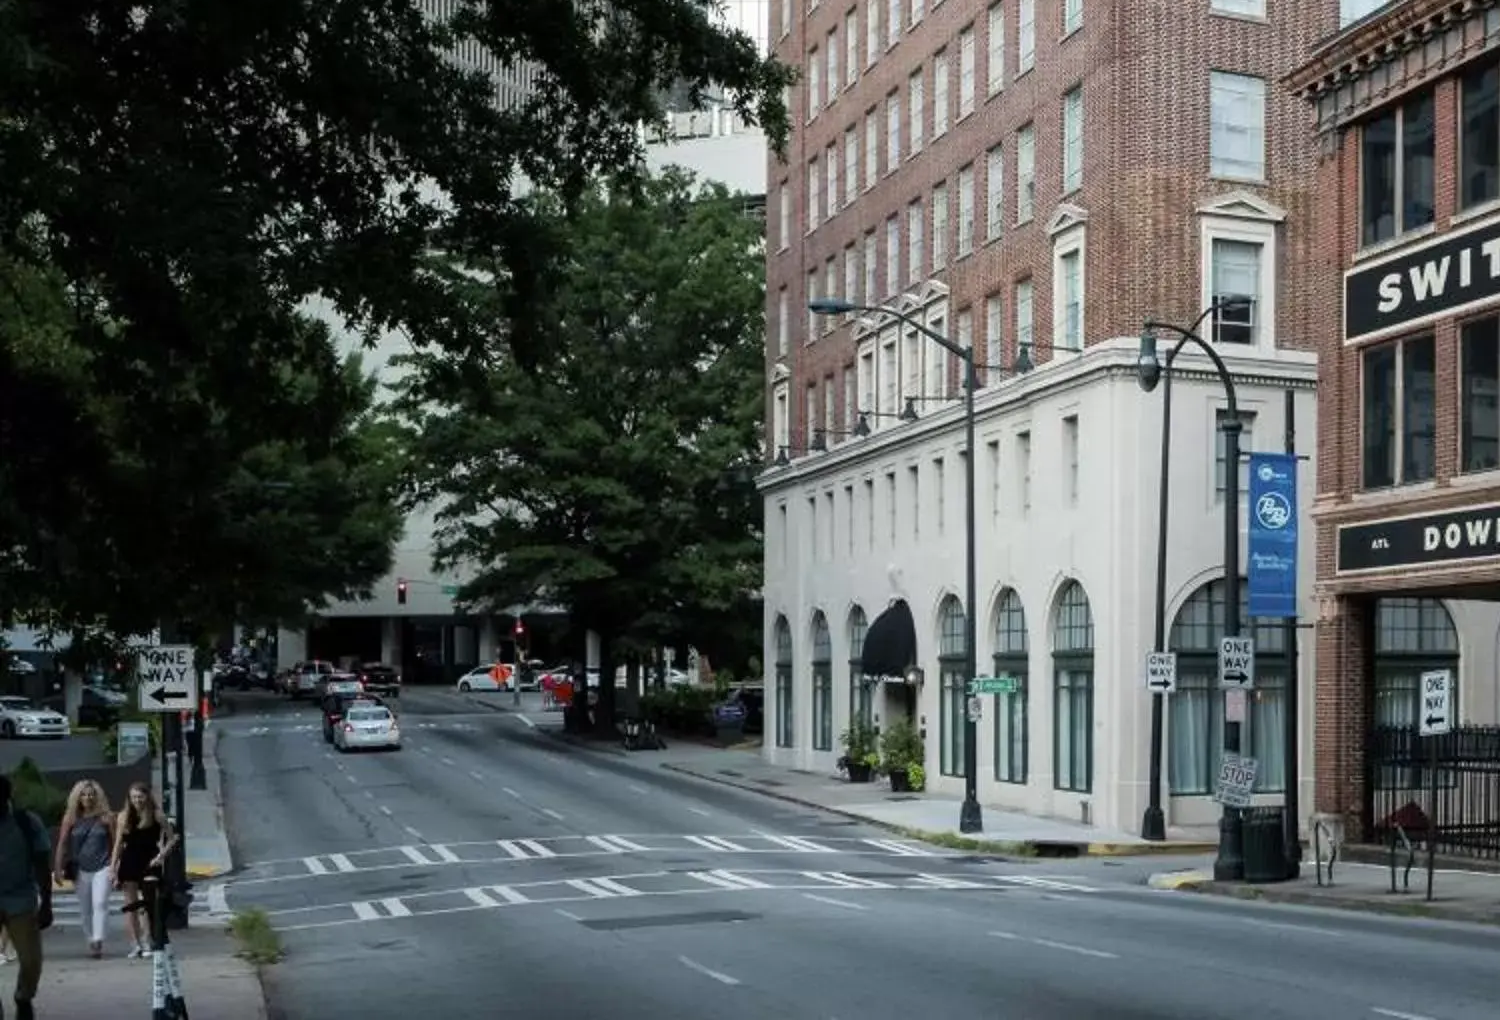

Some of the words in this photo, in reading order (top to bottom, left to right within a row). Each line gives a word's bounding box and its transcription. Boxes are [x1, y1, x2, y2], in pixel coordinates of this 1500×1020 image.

[1371, 537, 1390, 549] ATL
[1223, 641, 1250, 654] ONE
[150, 649, 187, 665] ONE
[1149, 655, 1173, 665] ONE
[1224, 657, 1249, 669] WAY
[147, 667, 187, 682] WAY
[1149, 667, 1173, 677] WAY
[1426, 676, 1445, 692] ONE
[1426, 696, 1445, 709] WAY
[1220, 764, 1253, 786] STOP
